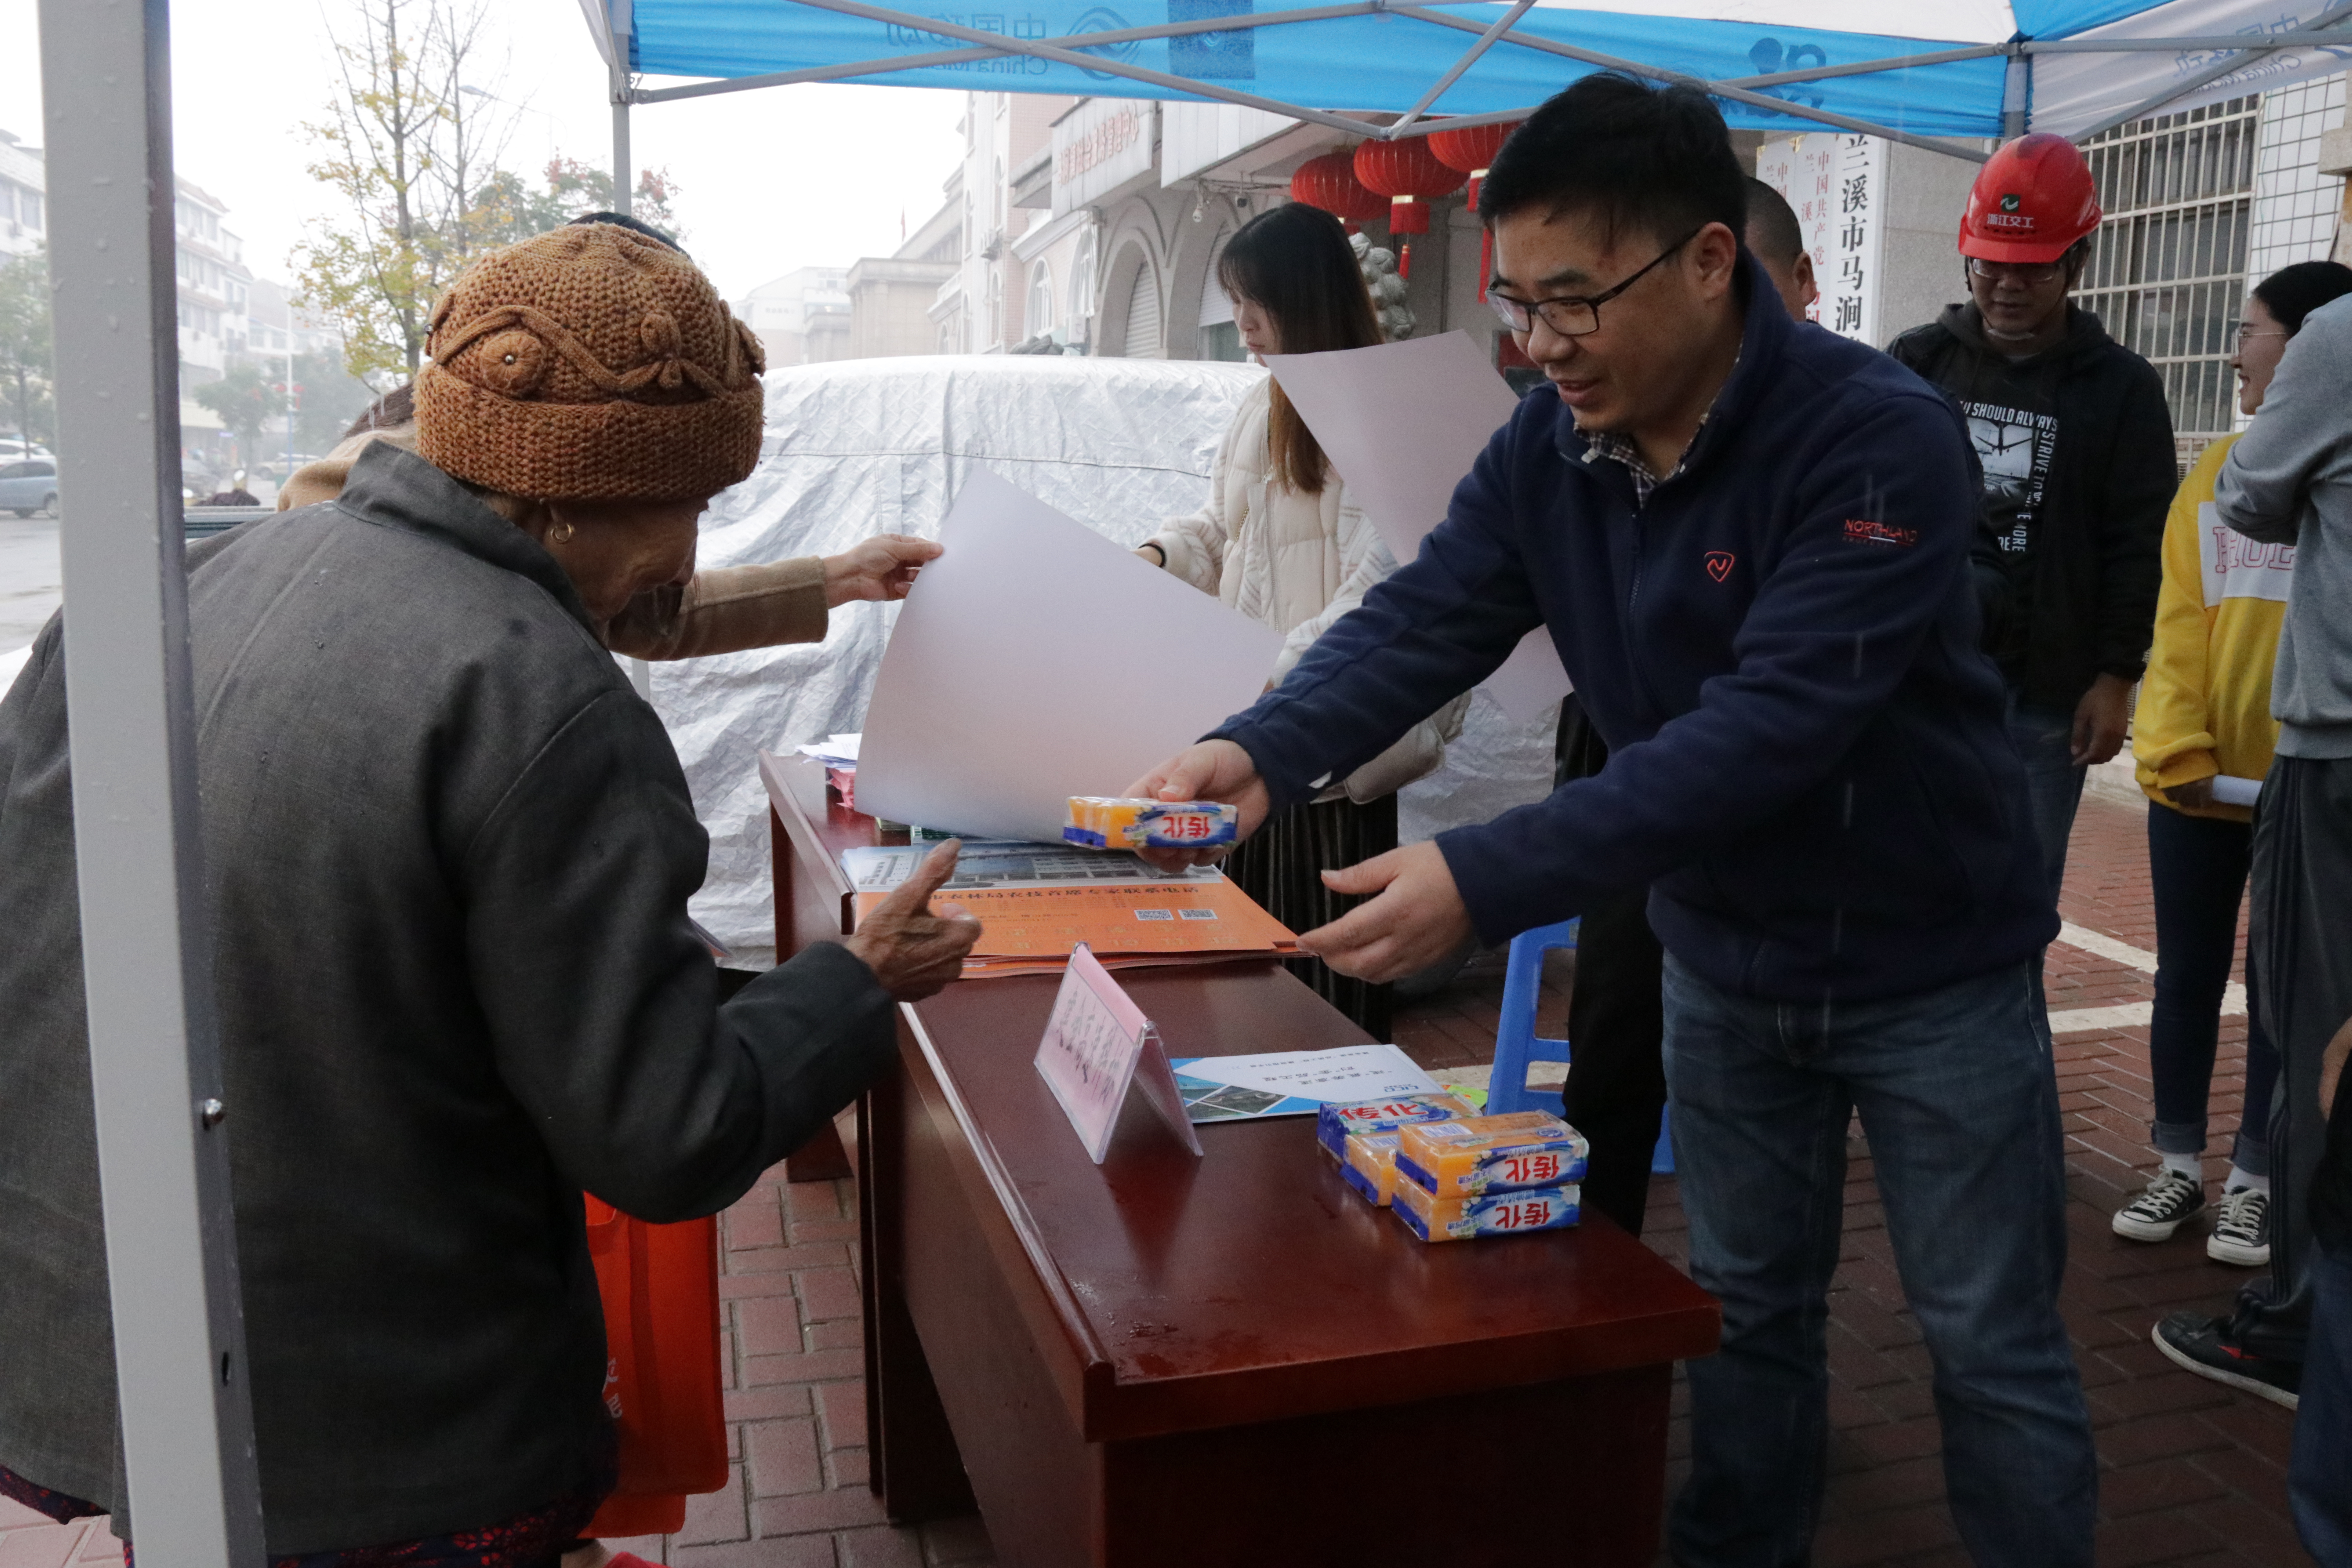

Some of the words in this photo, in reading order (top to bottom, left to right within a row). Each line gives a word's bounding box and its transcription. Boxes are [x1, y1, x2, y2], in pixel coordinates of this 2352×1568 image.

[1812, 151, 1830, 266] 中国共产党
[1987, 213, 2034, 228] 浙江交工
[1835, 134, 1870, 343] 兰溪市马涧
[1971, 402, 2015, 423] SHOULD
[2033, 431, 2056, 473] STRIVE
[1844, 519, 1917, 542] NORTHLAND
[1163, 817, 1210, 838] 传化
[1338, 1103, 1429, 1120] 传化
[1504, 1154, 1560, 1183] 传化
[1495, 1200, 1551, 1229] 传化
